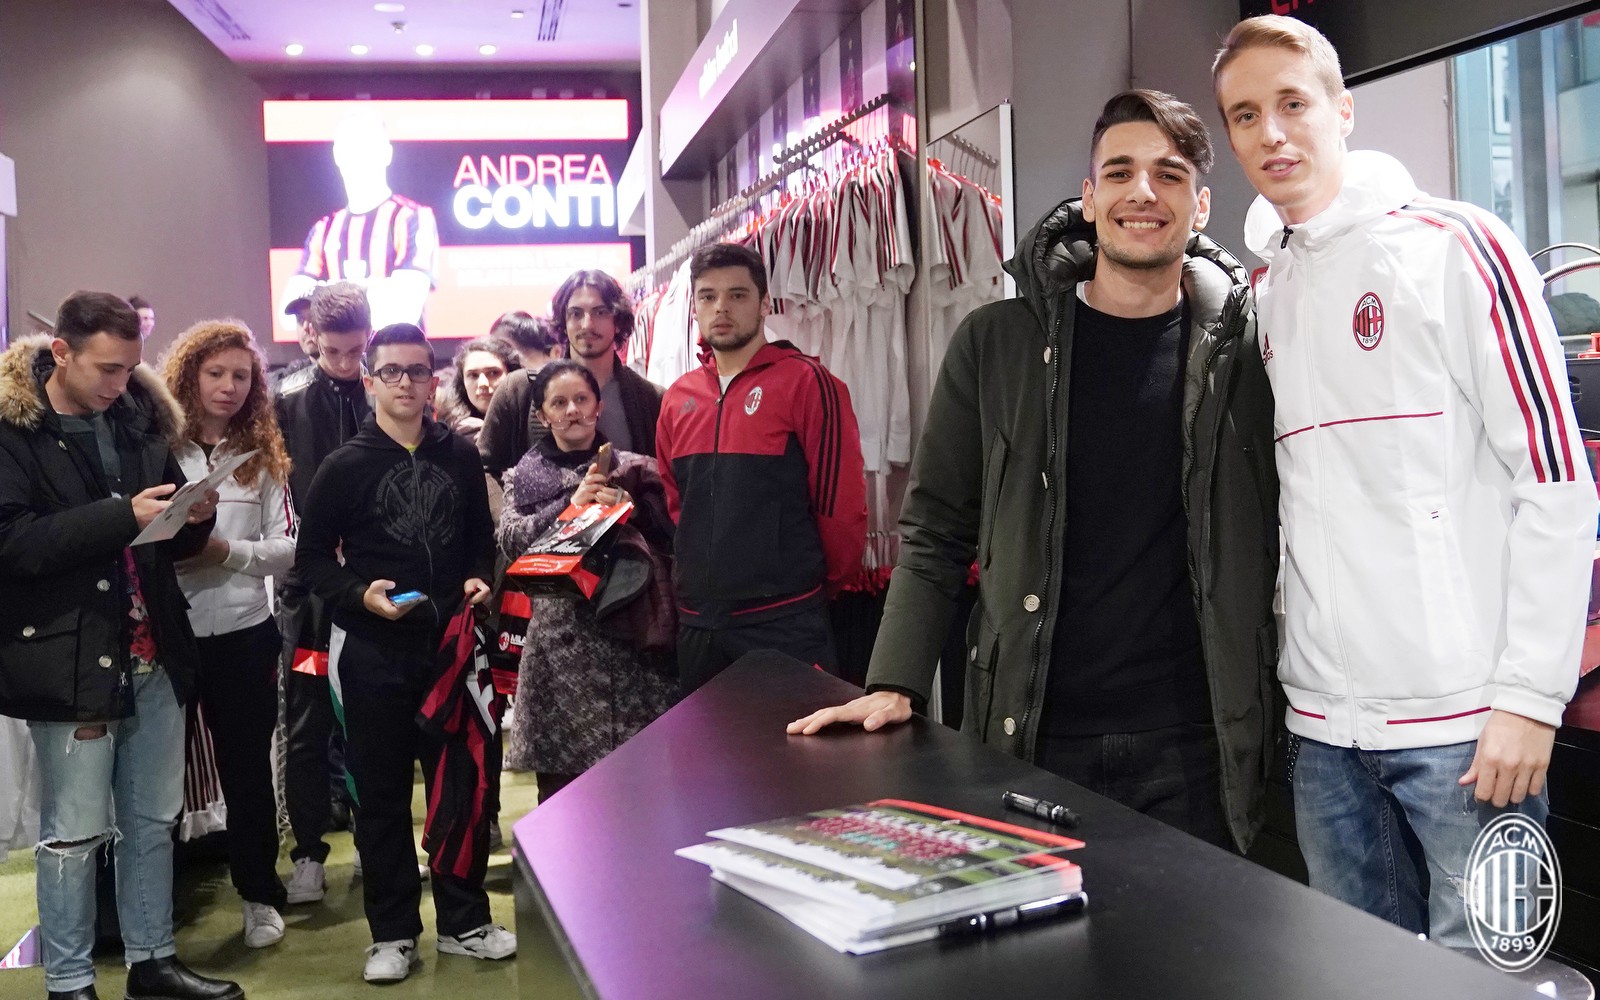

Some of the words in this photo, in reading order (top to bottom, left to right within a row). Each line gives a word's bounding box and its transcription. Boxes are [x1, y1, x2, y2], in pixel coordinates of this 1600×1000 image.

[453, 154, 613, 188] ANDREA
[453, 184, 615, 229] CONTI
[1361, 297, 1377, 308] ACM
[1362, 336, 1378, 345] 1899
[510, 633, 528, 646] MILA
